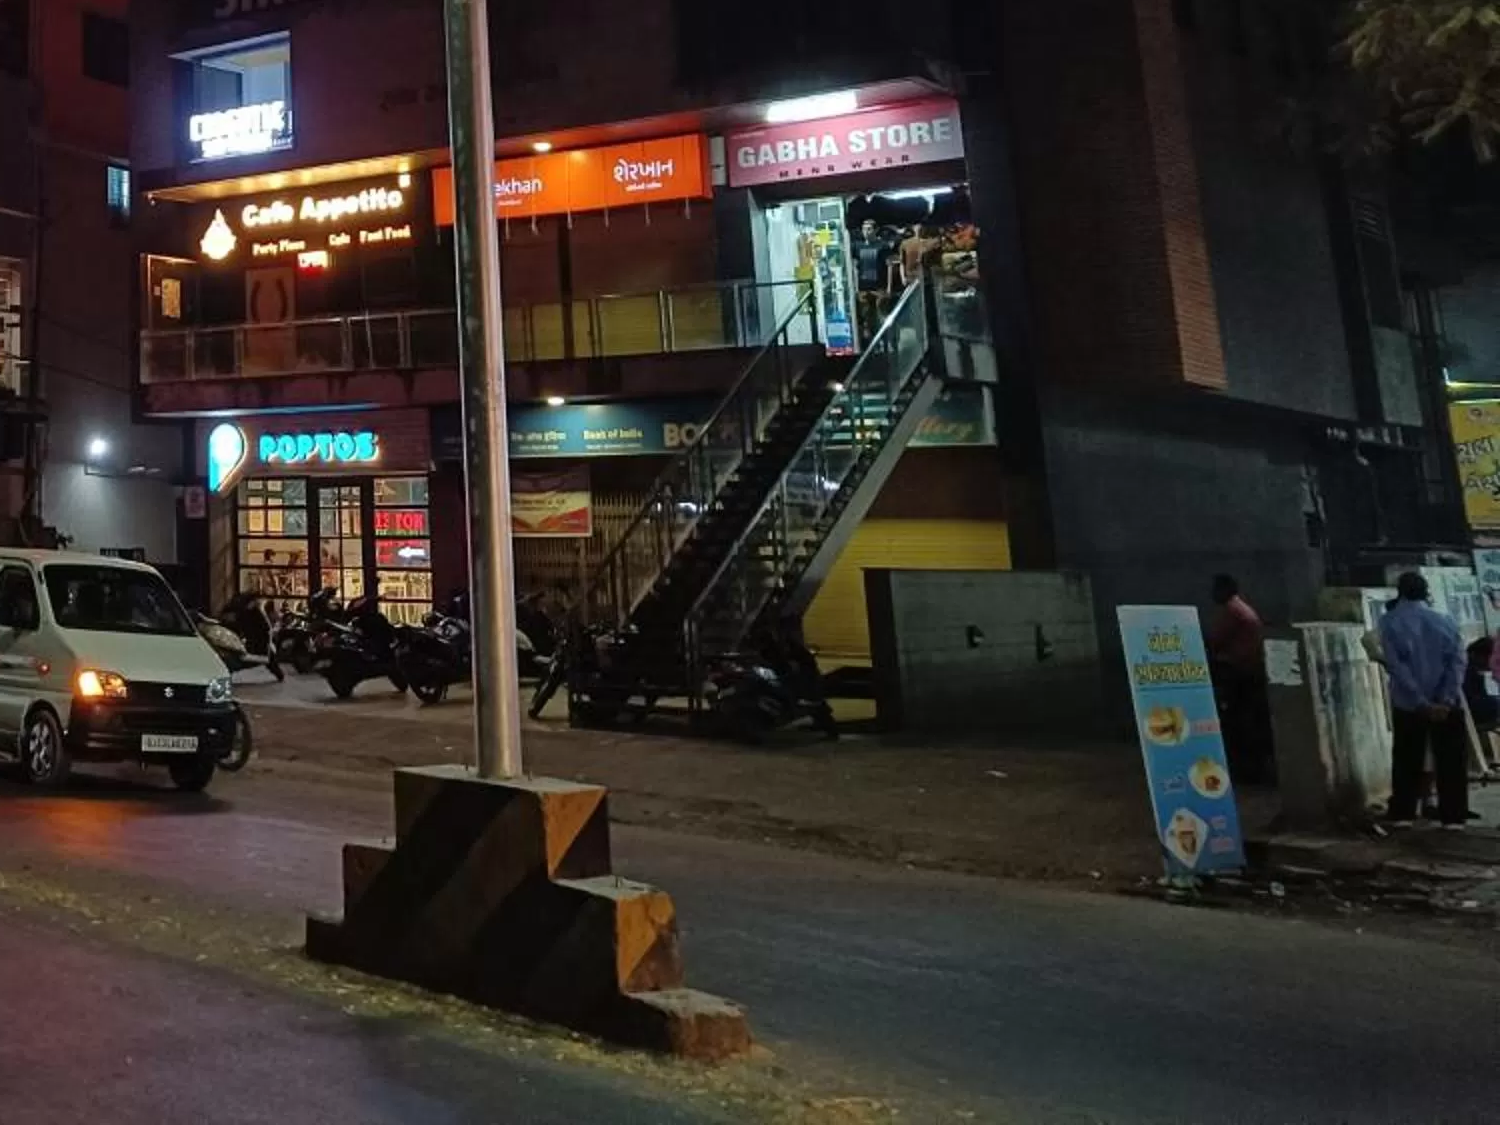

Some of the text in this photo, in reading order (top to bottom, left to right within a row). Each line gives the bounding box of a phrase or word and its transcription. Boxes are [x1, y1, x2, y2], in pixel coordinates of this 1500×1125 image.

[737, 118, 951, 168] GABHA STORE
[852, 155, 910, 169] WEAR
[242, 200, 294, 226] Cafe
